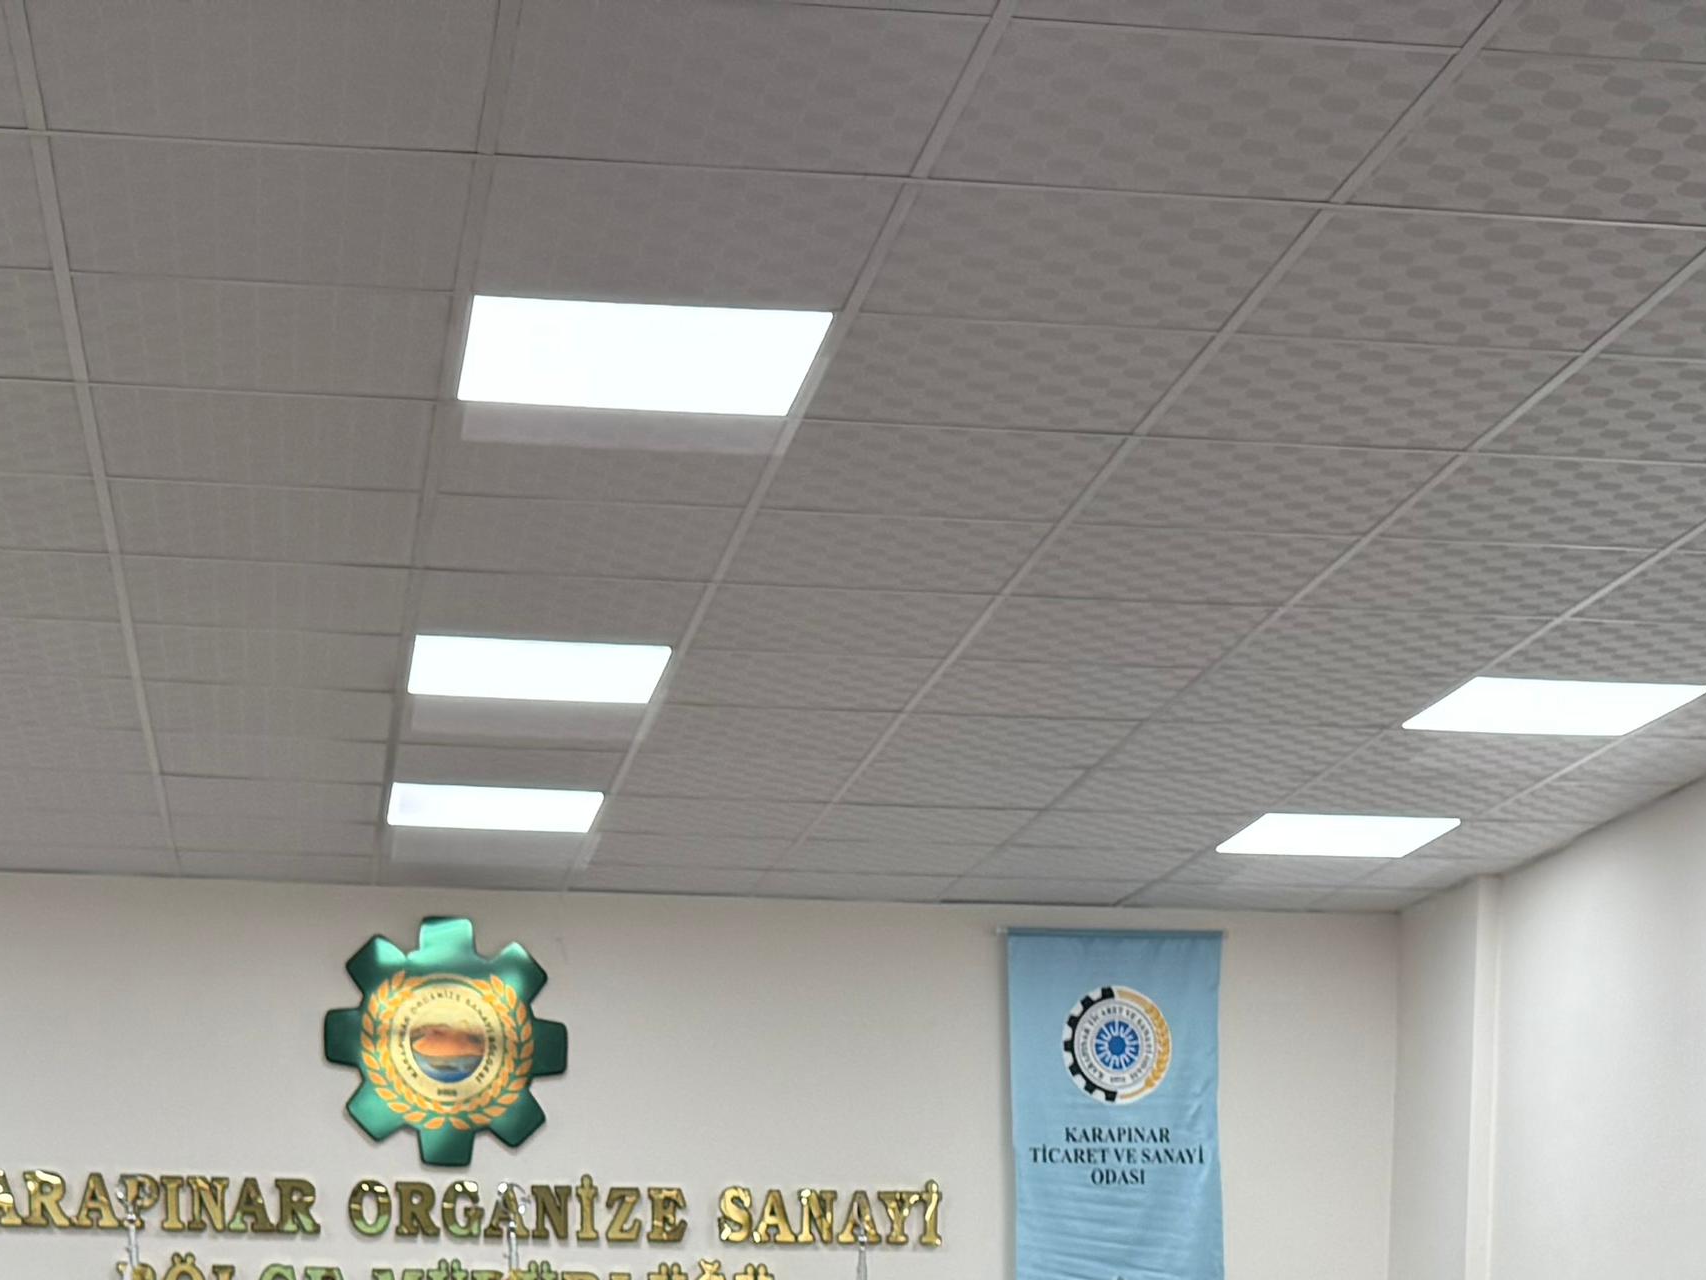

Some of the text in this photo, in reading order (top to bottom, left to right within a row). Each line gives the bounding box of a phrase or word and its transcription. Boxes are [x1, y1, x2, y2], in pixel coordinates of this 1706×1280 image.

[1064, 1126, 1171, 1144] KARAPINAR
[1028, 1143, 1205, 1165] TİCARET VE SANAYİ
[1090, 1167, 1145, 1186] ODASI
[348, 1173, 688, 1243] ORGANİZE
[717, 1178, 943, 1247] SANAYİ
